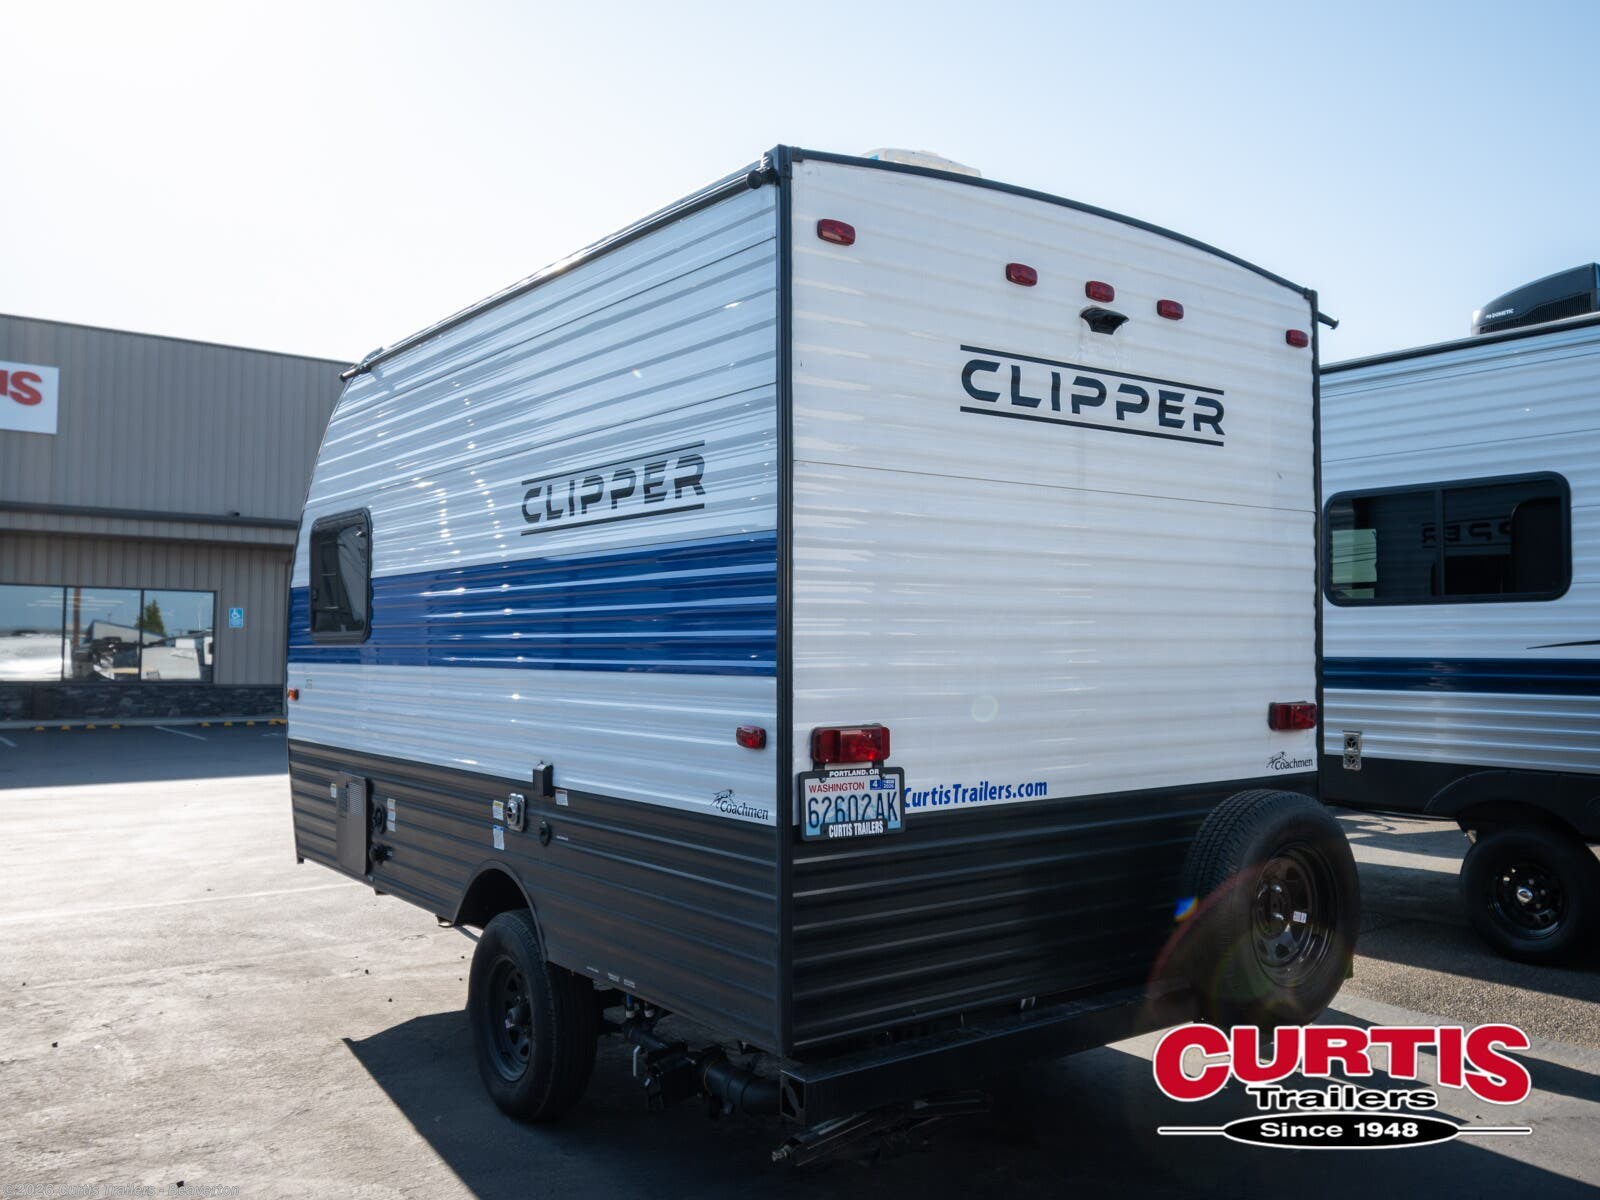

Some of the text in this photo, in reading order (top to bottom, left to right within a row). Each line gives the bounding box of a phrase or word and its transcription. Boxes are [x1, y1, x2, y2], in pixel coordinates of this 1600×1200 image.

[961, 359, 1225, 435] CLIPPER
[521, 453, 706, 524] CLIPPER
[1275, 757, 1313, 770] Coachmen
[809, 783, 865, 793] WASHINGTON
[904, 781, 1048, 808] CurtisTrailers.com
[720, 800, 769, 820] Coachmen
[809, 792, 897, 827] 62602AK
[829, 821, 884, 838] CURTIS TRAILERS
